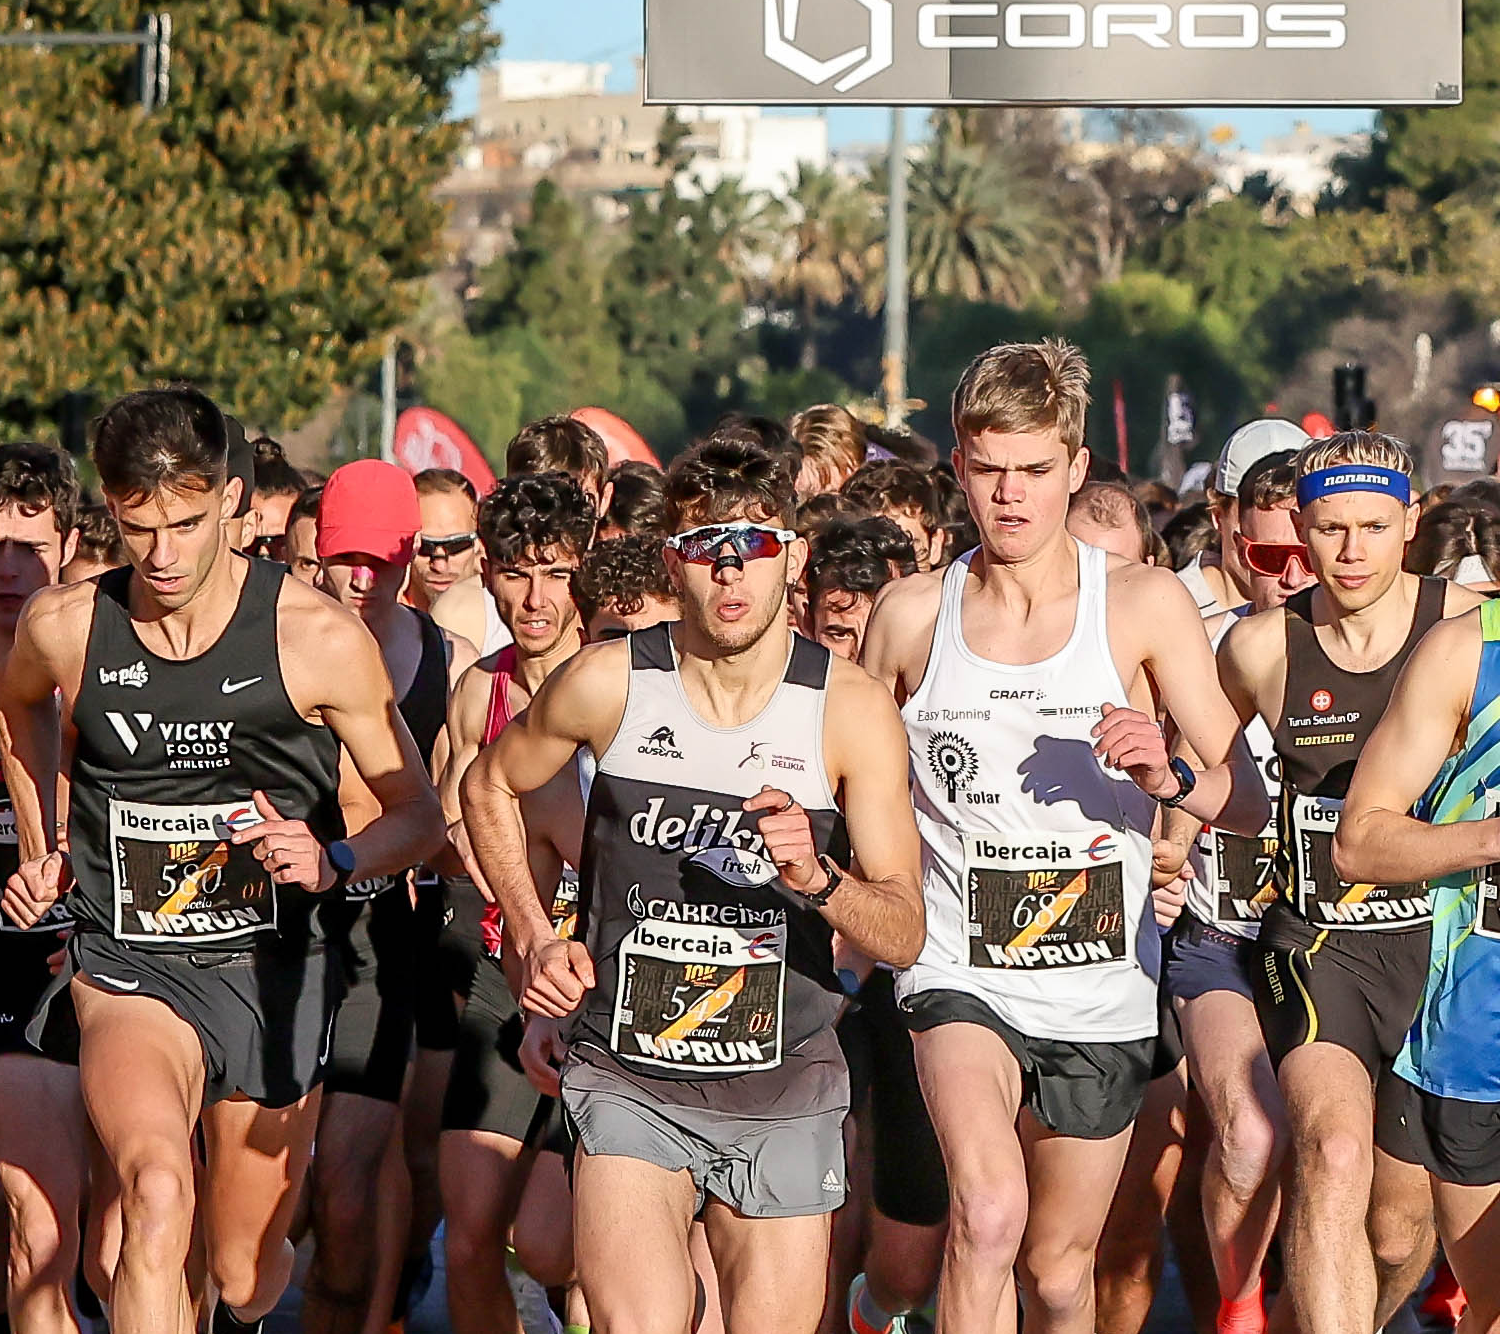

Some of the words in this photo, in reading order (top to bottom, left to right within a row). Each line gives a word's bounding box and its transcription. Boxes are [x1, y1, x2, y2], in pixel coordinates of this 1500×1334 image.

[916, 2, 1348, 50] COROS
[1323, 474, 1389, 487] noname
[99, 667, 118, 684] be
[990, 690, 1035, 700] CRAFT
[918, 710, 940, 722] Easy
[942, 709, 991, 721] Running
[1288, 716, 1312, 727] Turun
[1312, 714, 1346, 726] Seudun
[1347, 712, 1360, 723] OP
[158, 722, 235, 741] VICKY
[1294, 733, 1355, 746] noname
[165, 742, 229, 756] FOODS
[638, 745, 685, 759] austral
[169, 758, 231, 769] ATHLETICS
[966, 791, 1000, 805] solar
[120, 810, 211, 834] Ibercaja
[168, 842, 200, 861] 10K
[976, 841, 1072, 863] Ibercaja
[722, 857, 762, 875] fresh
[157, 863, 223, 897] 580
[1027, 871, 1059, 890] 10K
[1012, 894, 1082, 929] 687
[1318, 896, 1432, 923] KIPRUN
[136, 906, 262, 933] KIPRUN
[1096, 913, 1120, 934] 01
[633, 927, 733, 957] Ibercaja
[1028, 932, 1068, 947] greven
[985, 940, 1113, 967] KIPRUN
[684, 964, 718, 982] 10K
[662, 986, 735, 1023] 542
[749, 1012, 774, 1034] 01
[634, 1032, 764, 1063] KIPRUN
